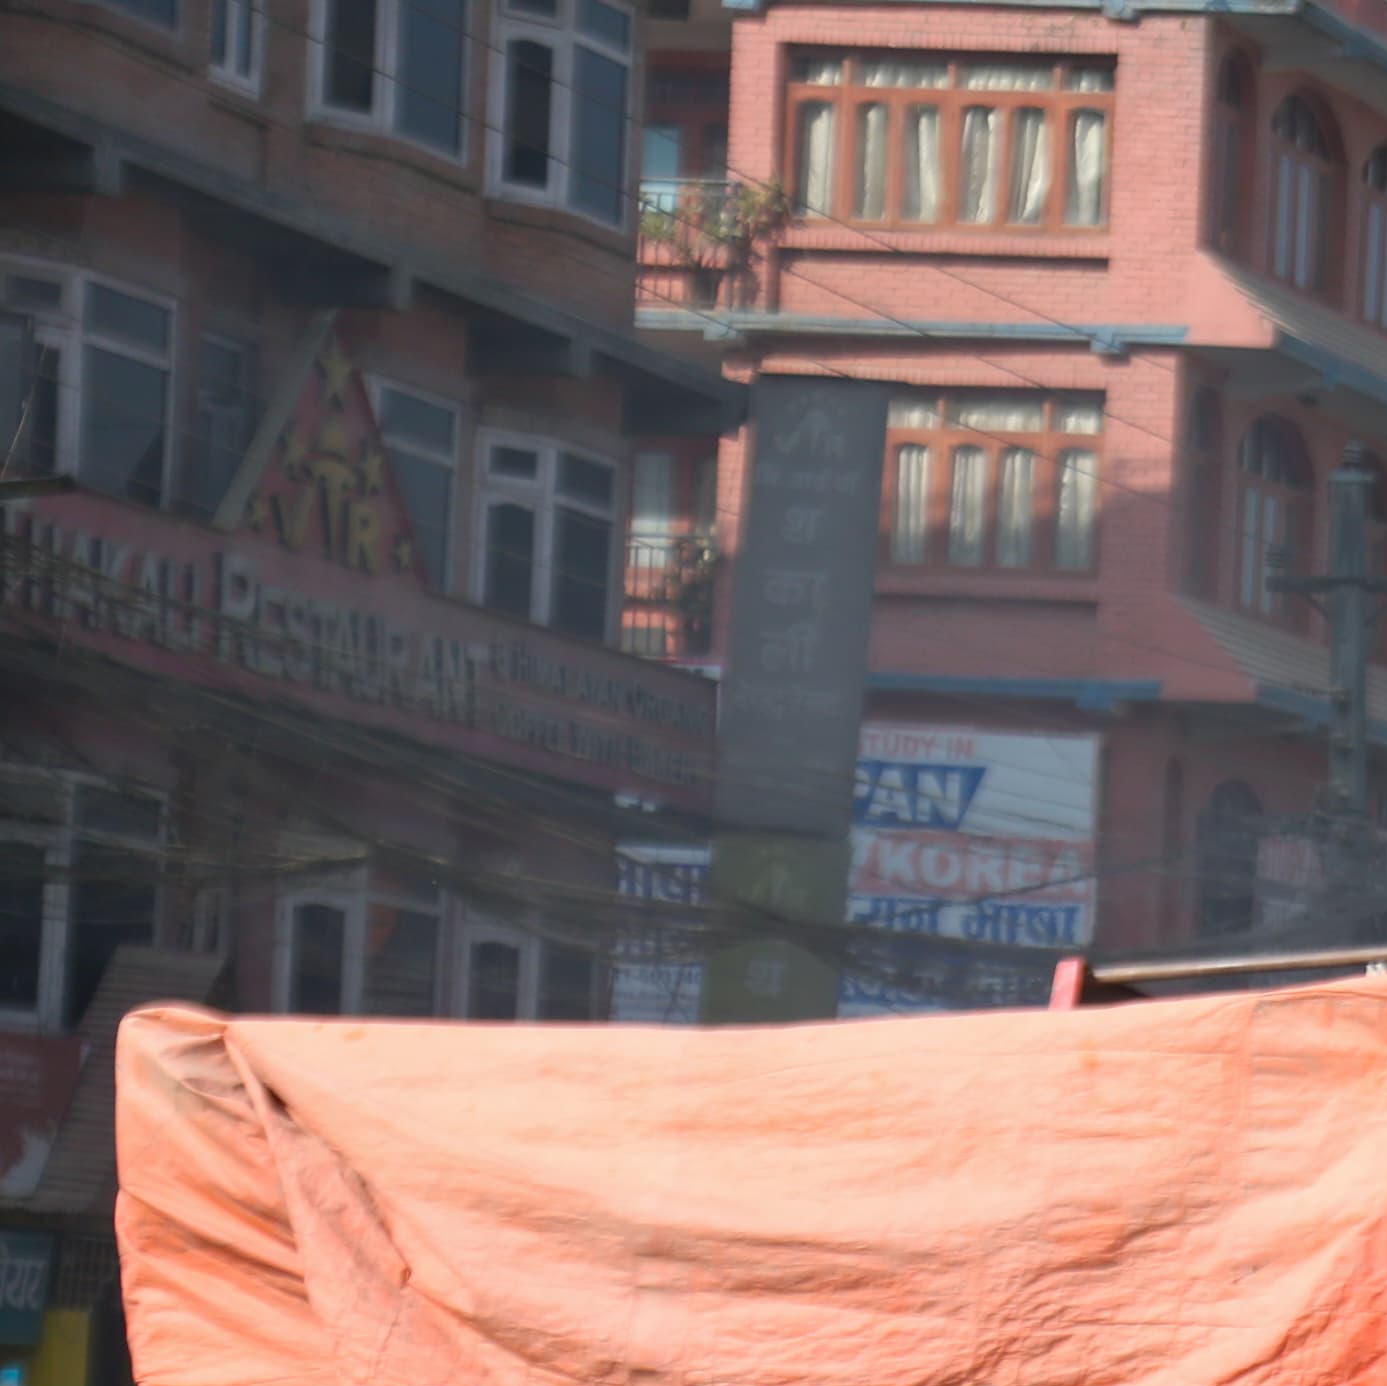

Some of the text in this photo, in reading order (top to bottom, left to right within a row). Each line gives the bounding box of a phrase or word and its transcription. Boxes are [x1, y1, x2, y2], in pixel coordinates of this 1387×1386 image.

[271, 458, 382, 574] VTR
[219, 551, 491, 728] RESTAURANT
[878, 839, 1088, 895] KOREA
